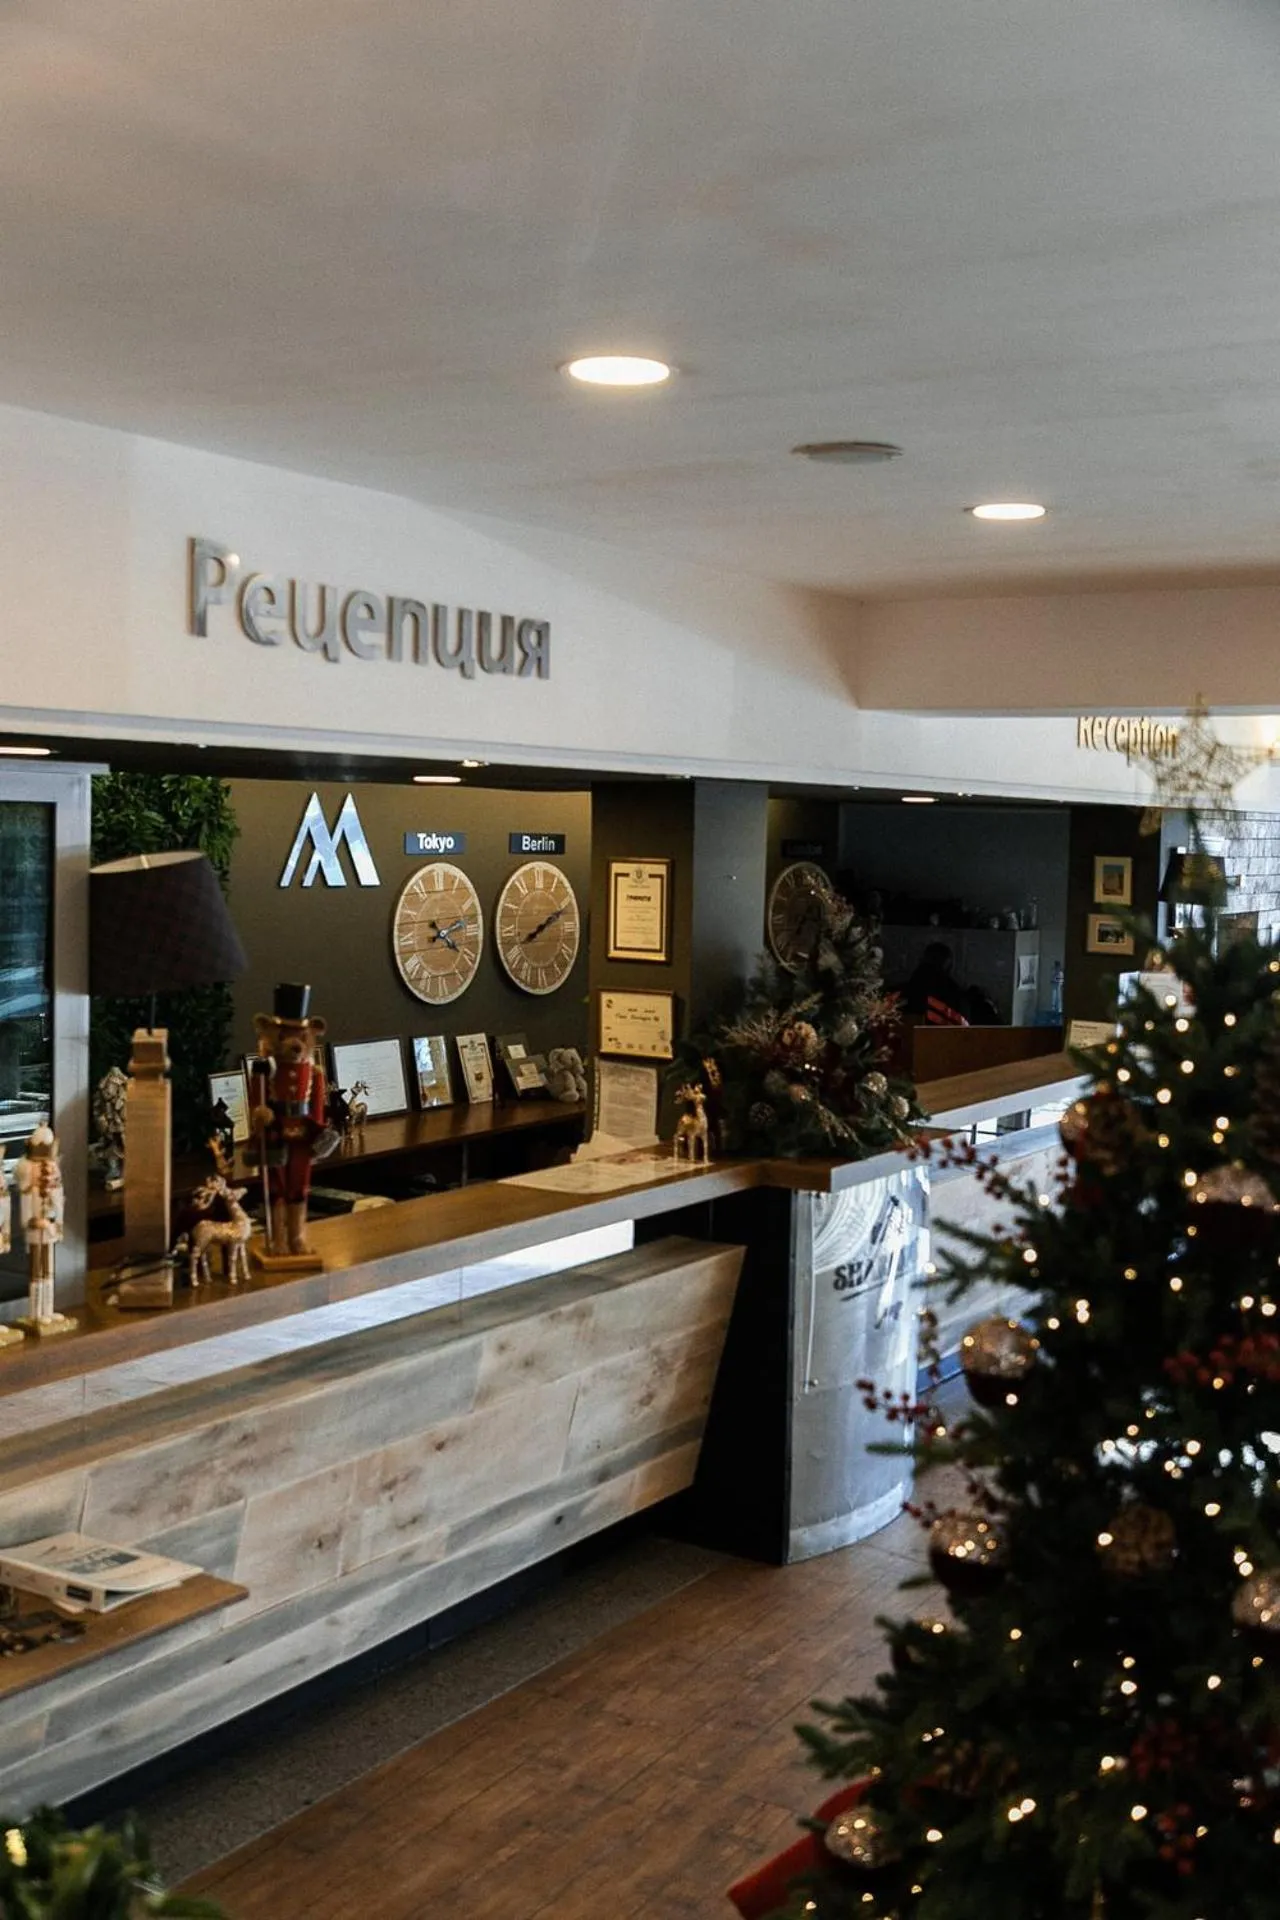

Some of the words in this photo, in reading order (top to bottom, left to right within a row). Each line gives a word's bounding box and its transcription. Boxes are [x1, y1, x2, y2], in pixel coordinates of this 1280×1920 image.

[186, 537, 551, 681] Рецепция
[1076, 715, 1178, 768] Reception
[417, 833, 455, 853] Tokyo
[521, 835, 556, 851] Berlin
